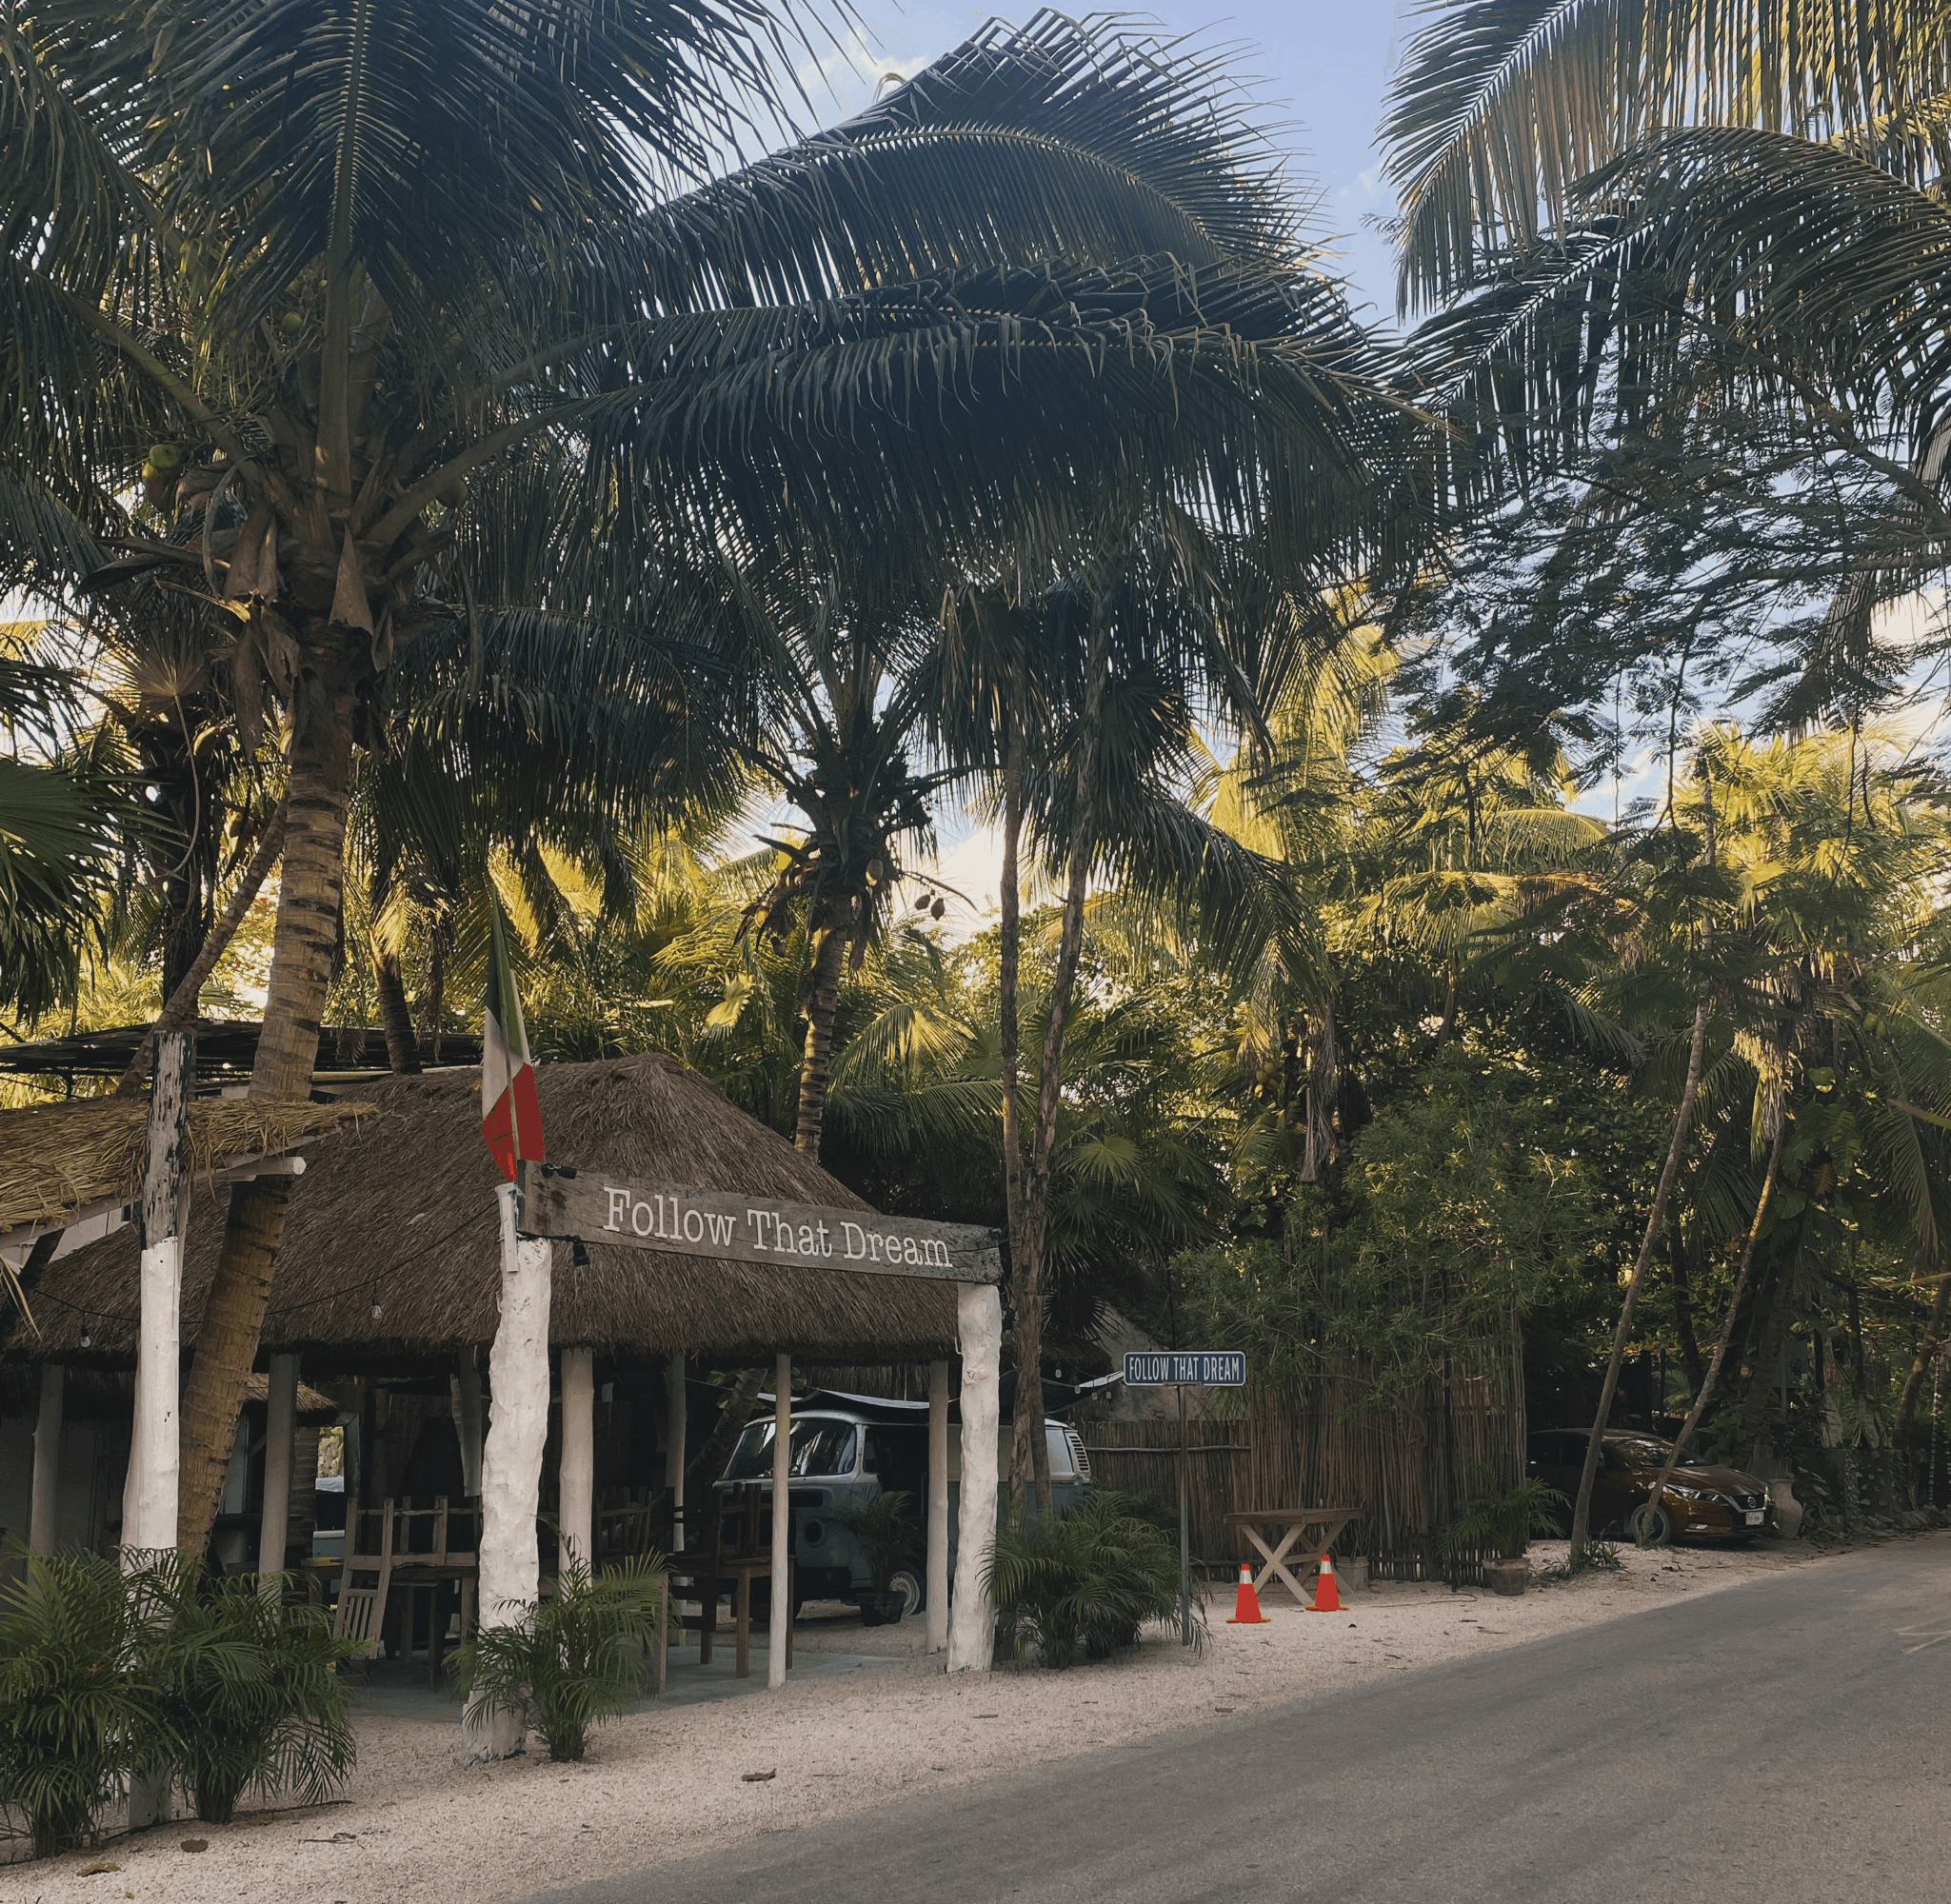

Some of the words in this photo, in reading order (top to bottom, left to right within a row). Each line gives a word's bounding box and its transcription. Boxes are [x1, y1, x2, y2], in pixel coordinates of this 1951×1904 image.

[603, 1186, 737, 1247] Follow
[747, 1208, 833, 1258] That
[840, 1220, 954, 1268] Dream
[1128, 1357, 1169, 1381] FOLLOW
[1173, 1357, 1199, 1381] THAT
[1203, 1356, 1240, 1381] DREAM
